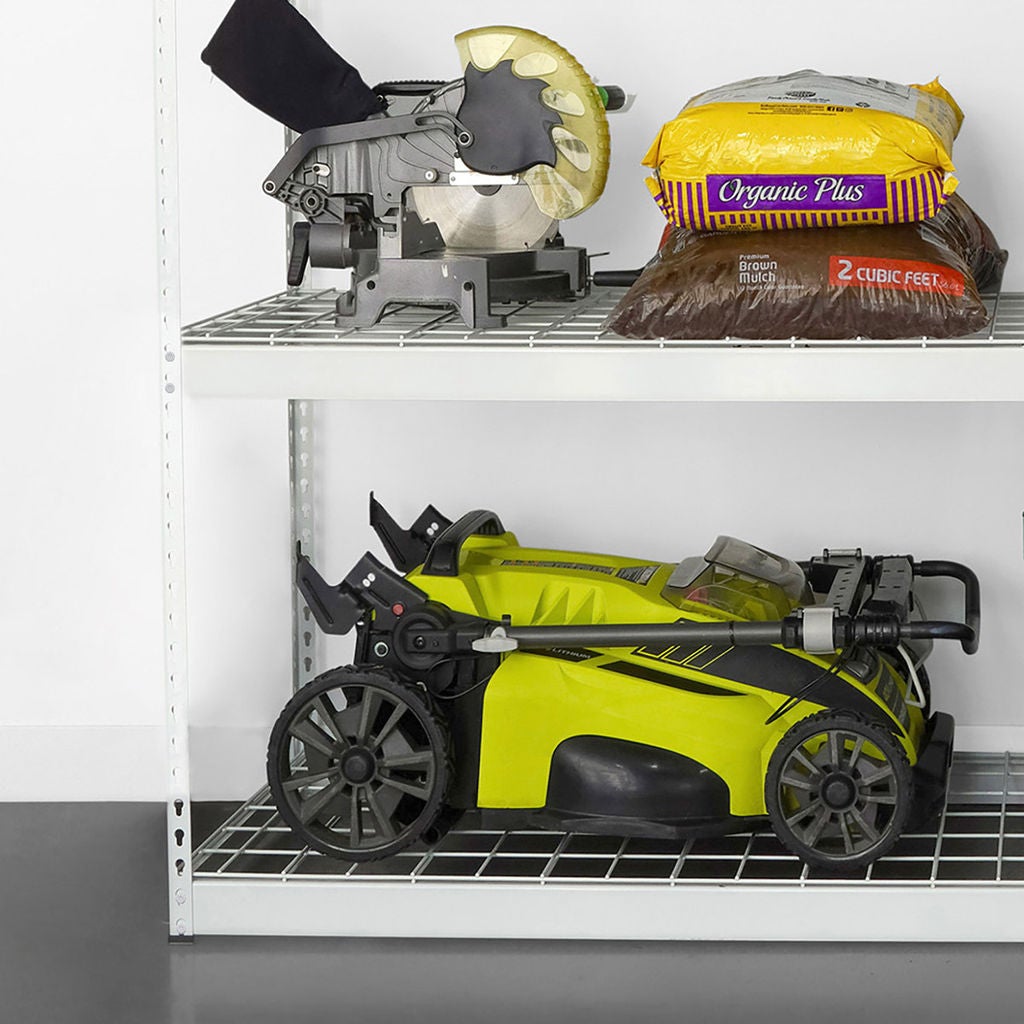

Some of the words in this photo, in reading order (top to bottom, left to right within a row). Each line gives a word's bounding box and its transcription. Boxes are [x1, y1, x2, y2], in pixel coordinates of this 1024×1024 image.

[718, 178, 808, 209] Organic
[814, 176, 865, 202] Plus
[739, 261, 777, 271] Brown
[837, 259, 853, 281] 2
[856, 267, 901, 284] CUBIC
[904, 271, 940, 287] FEET
[739, 271, 776, 284] Mulch
